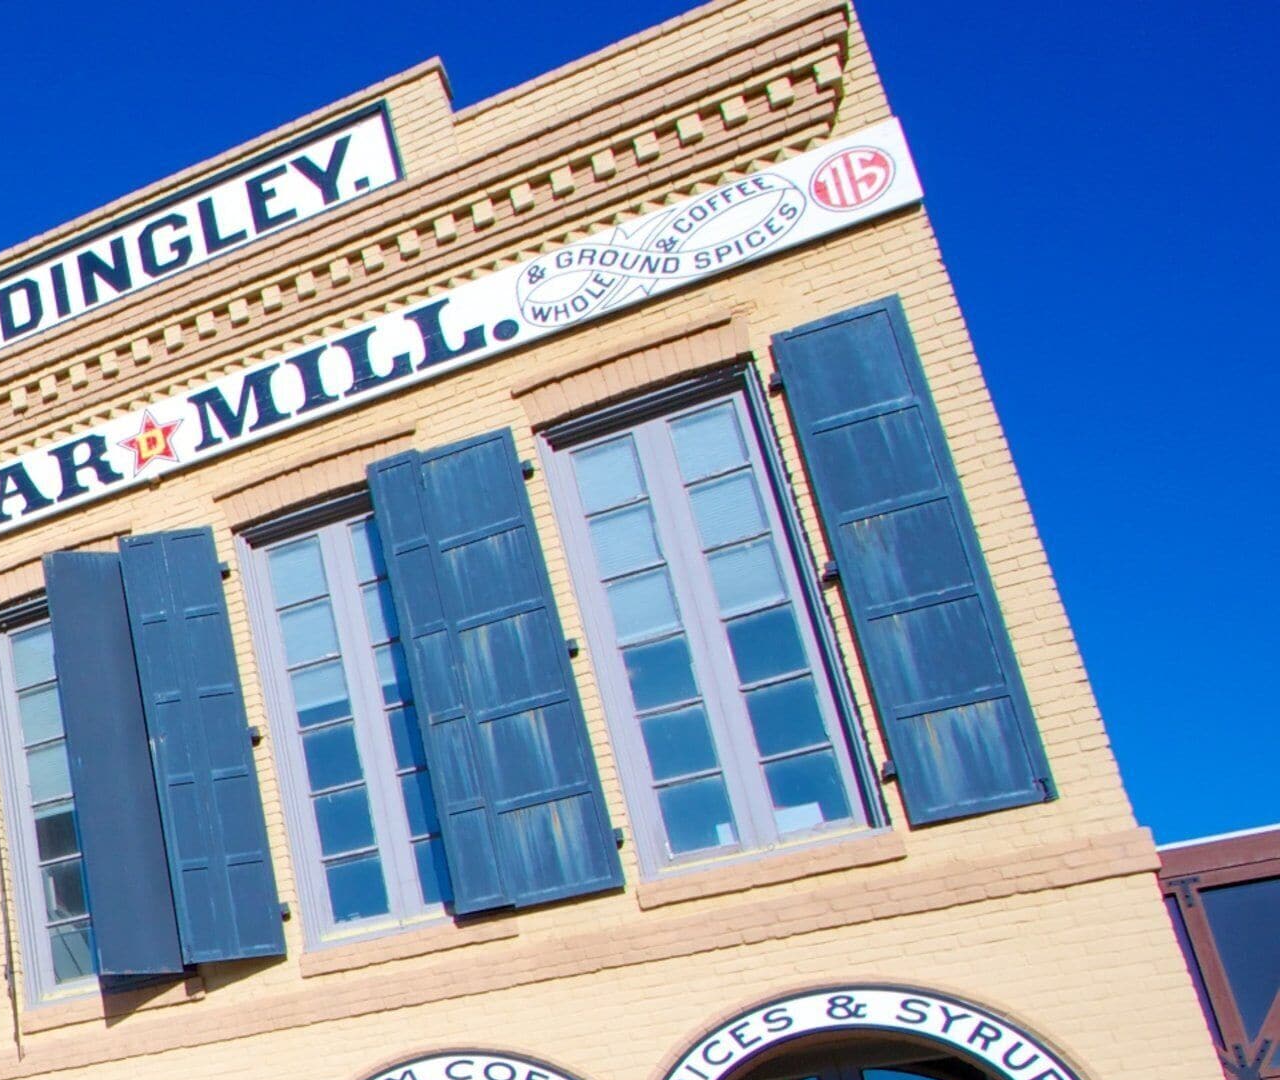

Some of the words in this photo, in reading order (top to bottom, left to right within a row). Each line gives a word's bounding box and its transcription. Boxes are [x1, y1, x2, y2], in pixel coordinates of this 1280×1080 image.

[813, 147, 890, 210] 115
[526, 265, 546, 285] &
[555, 248, 681, 275] GROUND
[694, 202, 799, 270] SPICES
[655, 235, 679, 253] &
[672, 176, 774, 233] COFFEE
[530, 272, 616, 323] WHOLE
[187, 299, 519, 452] MILL.
[137, 428, 165, 459] D
[826, 995, 868, 1021] &
